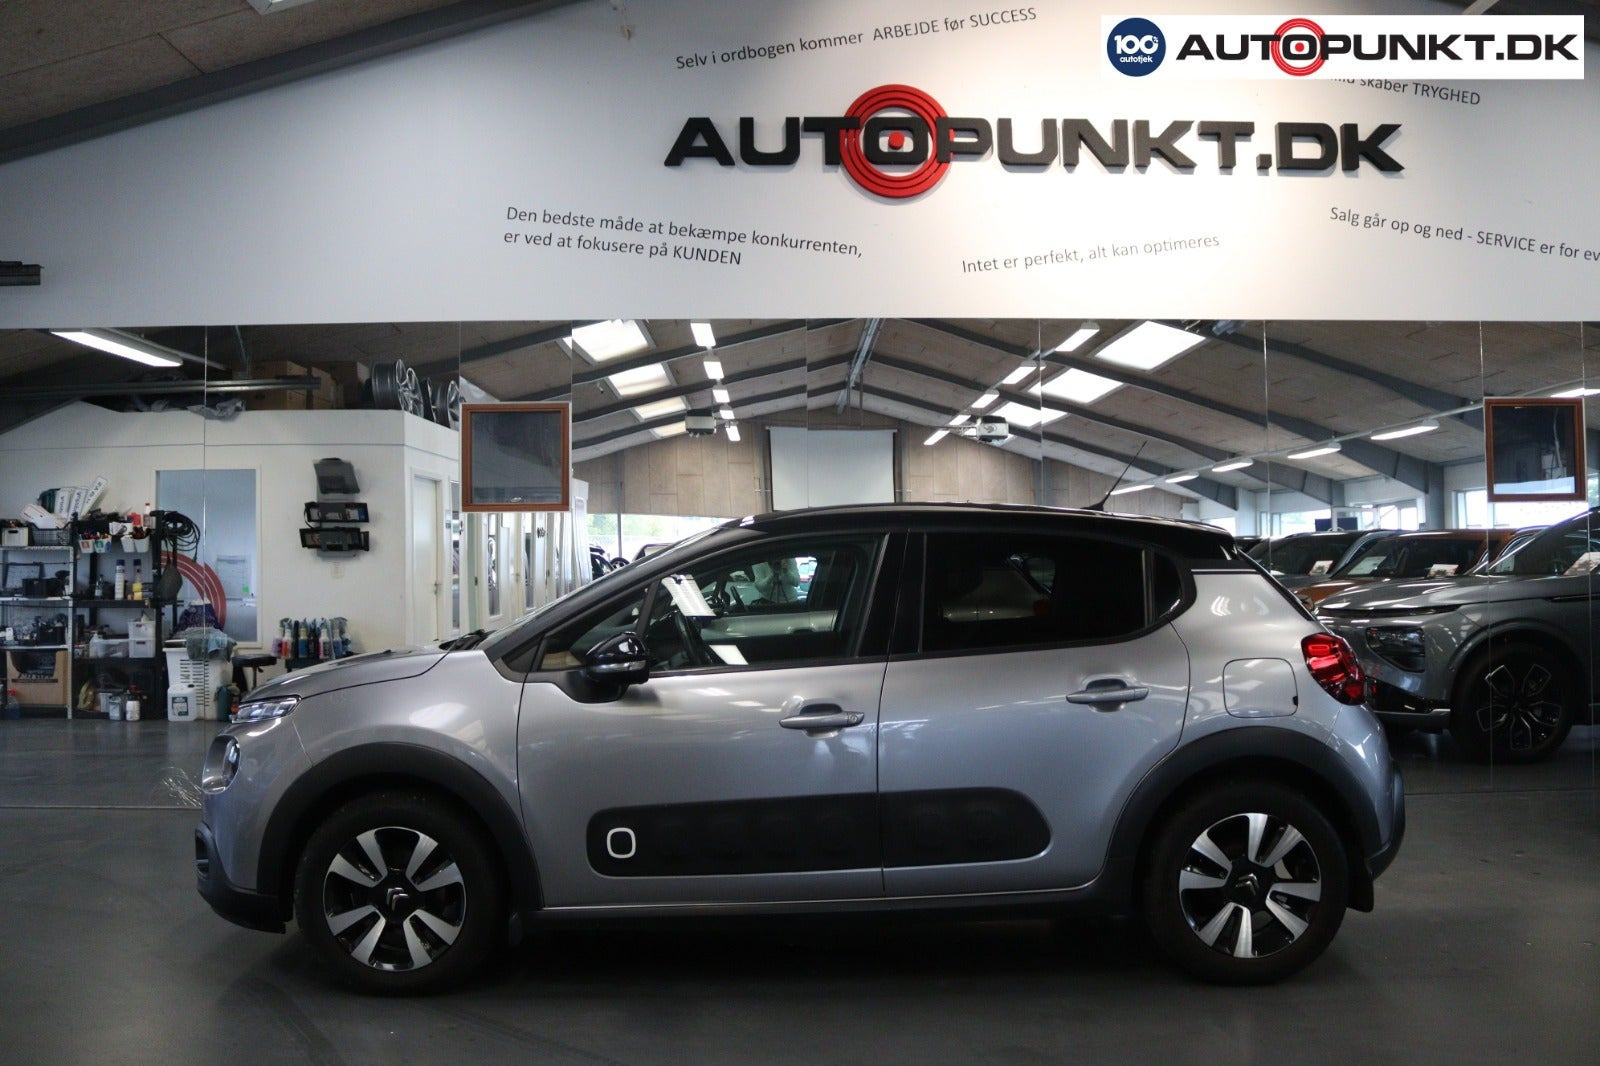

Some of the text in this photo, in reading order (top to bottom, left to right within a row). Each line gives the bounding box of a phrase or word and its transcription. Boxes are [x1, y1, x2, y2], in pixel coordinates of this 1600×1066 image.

[676, 8, 1036, 69] Selv i ordbogen kommer ARBEJDE før SUCCESS
[1413, 83, 1480, 104] TRYGHED
[664, 116, 1405, 174] AUTOPUNKT.DK
[504, 233, 742, 265] er ved at fokusere på KUNDEN
[507, 207, 861, 257] Den bedste måde at bekæmpe konkurrenten,
[963, 237, 1219, 272] Intet er perfekt, alt kan optimeres
[1330, 207, 1359, 226] Salg
[1364, 213, 1387, 228] går
[1391, 221, 1409, 234] op
[1414, 225, 1430, 238] og
[1436, 228, 1463, 240] ned
[1477, 231, 1535, 251] SERVICE
[1540, 244, 1555, 254] er
[1560, 243, 1579, 258] for
